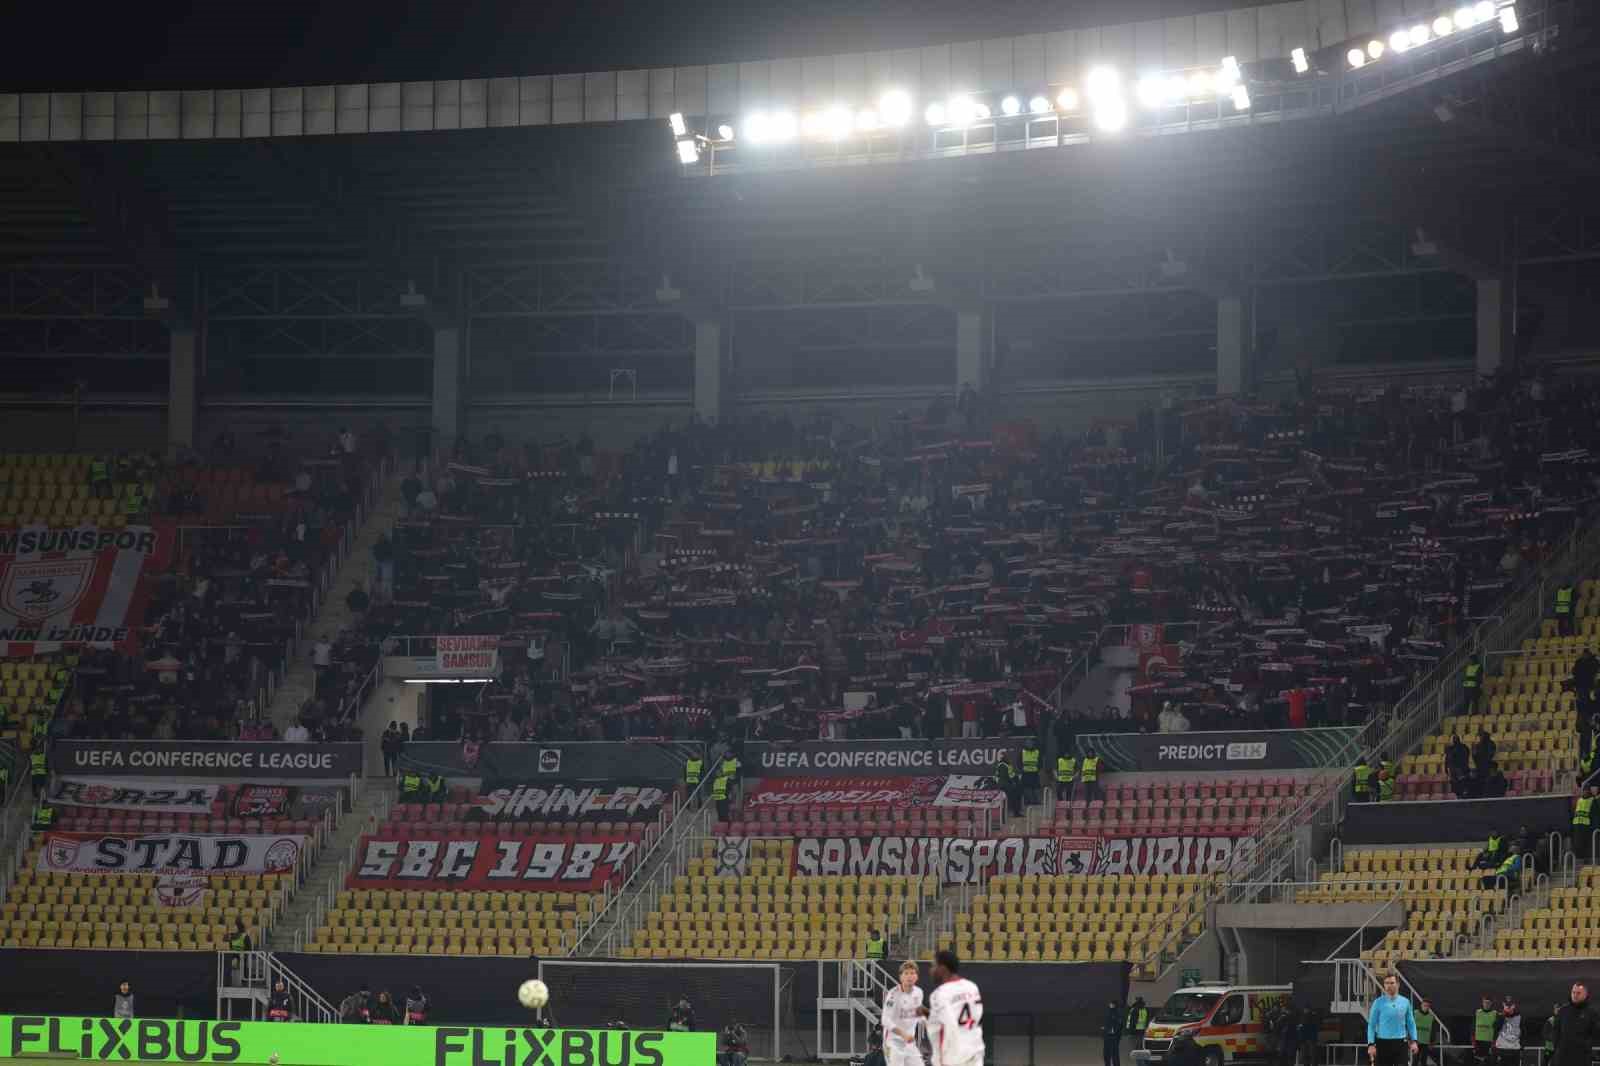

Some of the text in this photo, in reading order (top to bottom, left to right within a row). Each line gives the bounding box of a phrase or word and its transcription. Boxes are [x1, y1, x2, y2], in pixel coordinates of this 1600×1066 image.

[75, 751, 333, 769] UEFA CONFERENCE LEAGUE
[761, 751, 809, 769] UEFA
[814, 750, 933, 768] CONFERENCE
[1159, 743, 1264, 760] PREDICT SIX
[96, 837, 250, 870] STAD
[358, 840, 637, 881] SBC 1984
[797, 837, 1049, 882] SAMSUNSPOR
